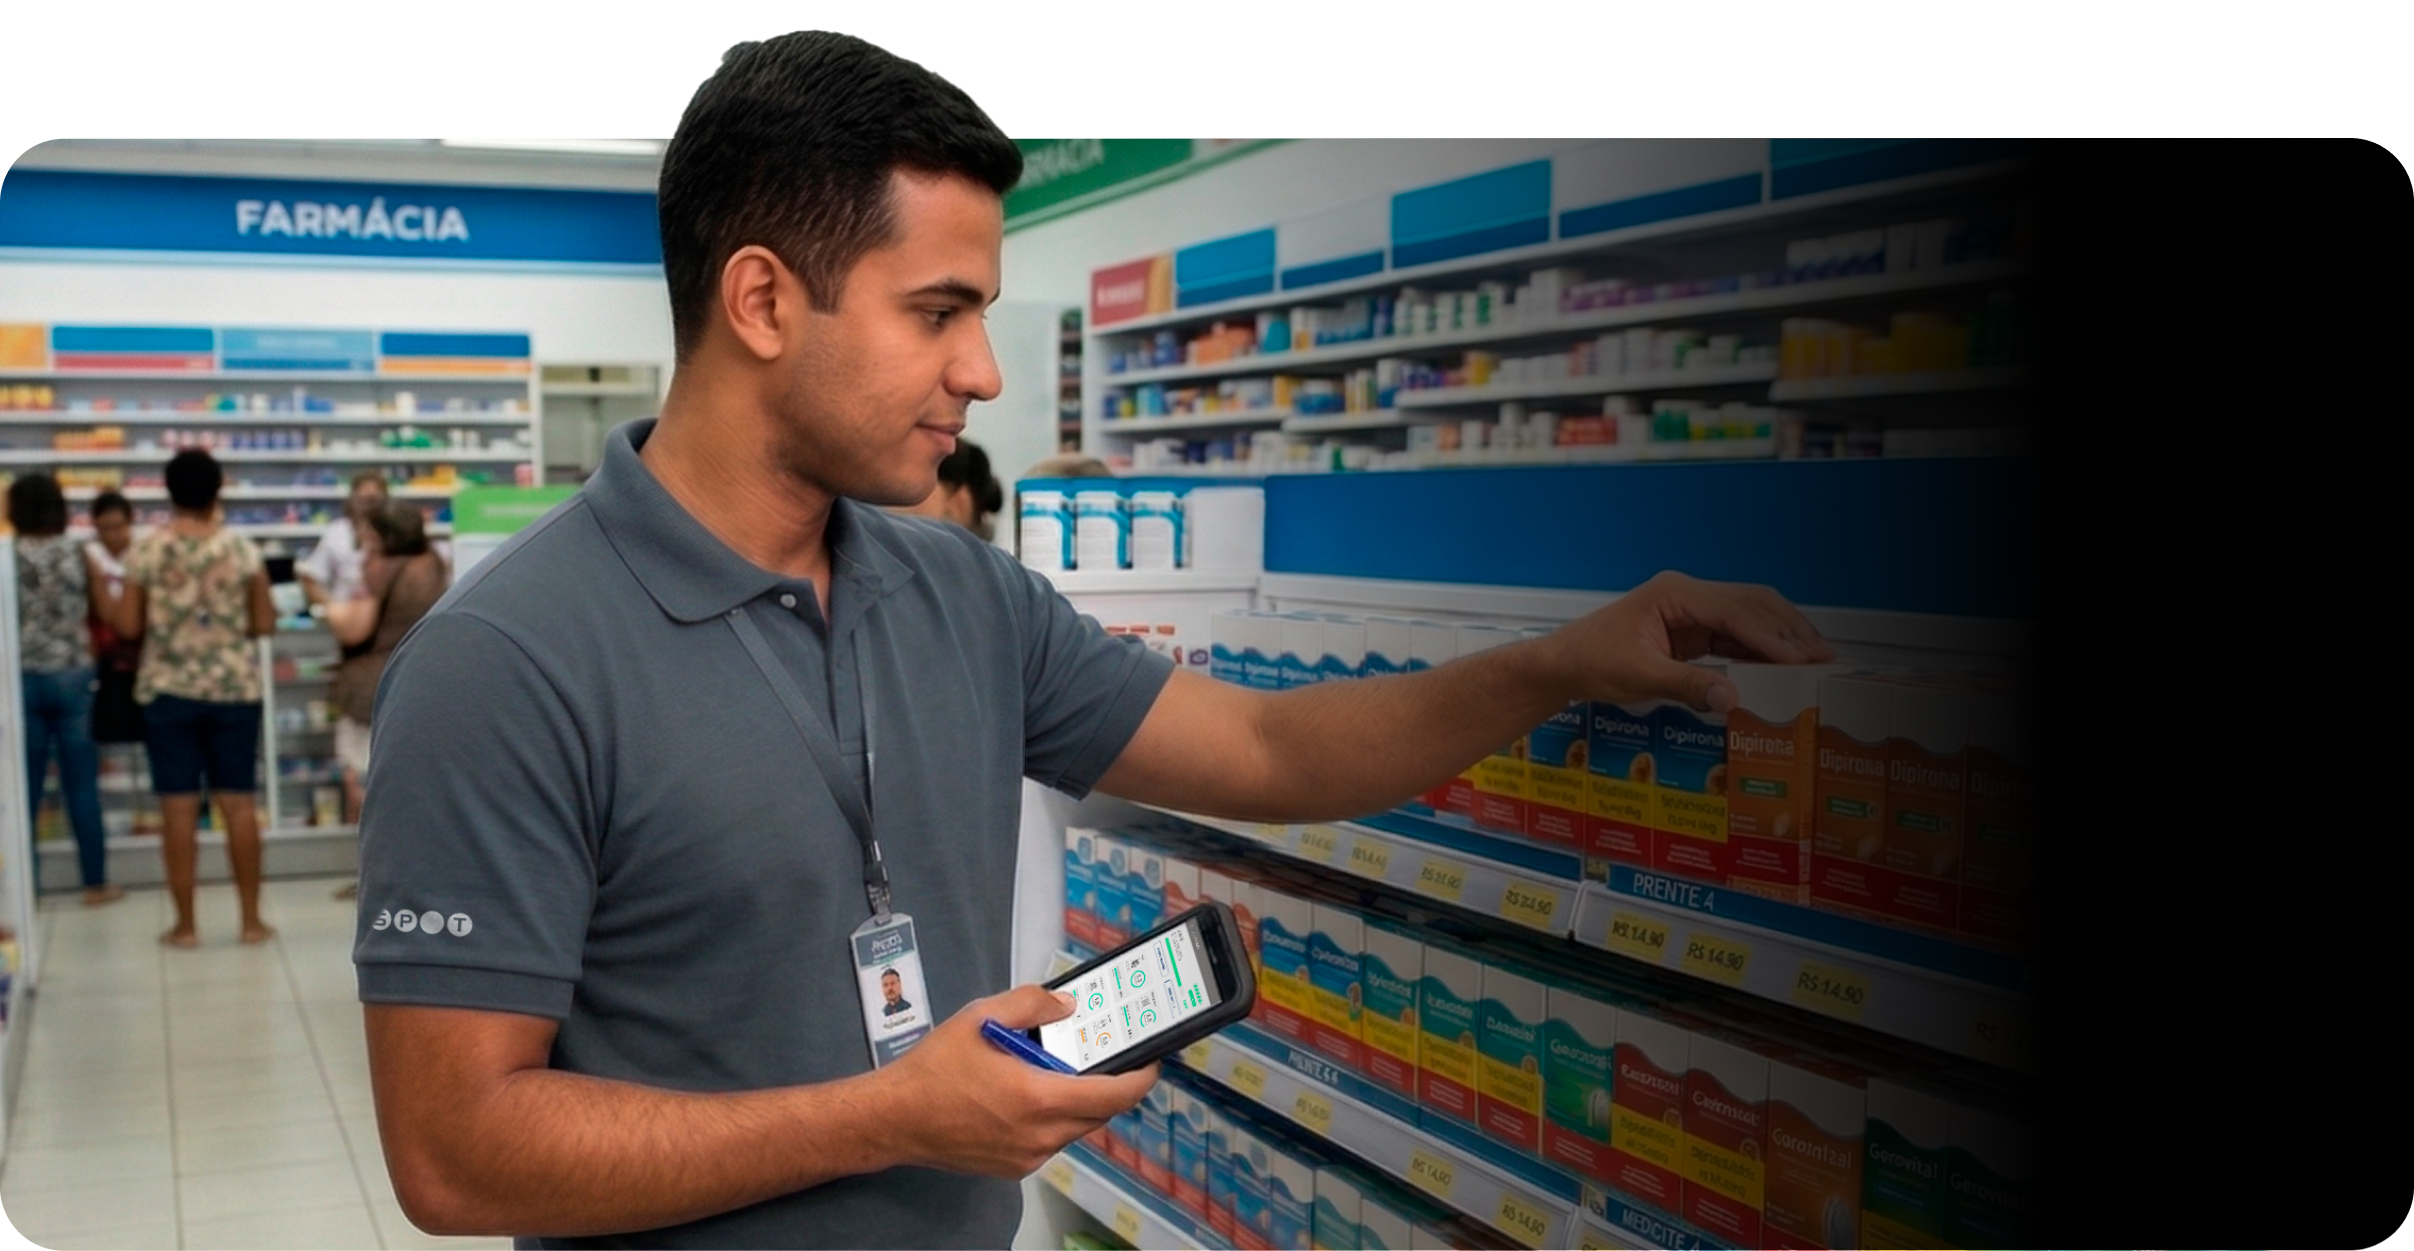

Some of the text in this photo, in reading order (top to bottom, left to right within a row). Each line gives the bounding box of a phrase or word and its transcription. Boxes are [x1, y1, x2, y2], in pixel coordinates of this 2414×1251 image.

[235, 196, 470, 243] FARMÁCIA
[1594, 714, 1650, 738] Dipirona
[1663, 725, 1725, 749] Dipirona
[1730, 730, 1796, 758] Dipirona
[1819, 747, 1885, 777] Dipirona
[1890, 759, 1961, 790] Dipirona
[1632, 872, 1702, 908] PRENTE
[372, 908, 473, 937] SPT
[1820, 978, 1864, 1005] 14.90
[1868, 1143, 1939, 1180] Gerovital
